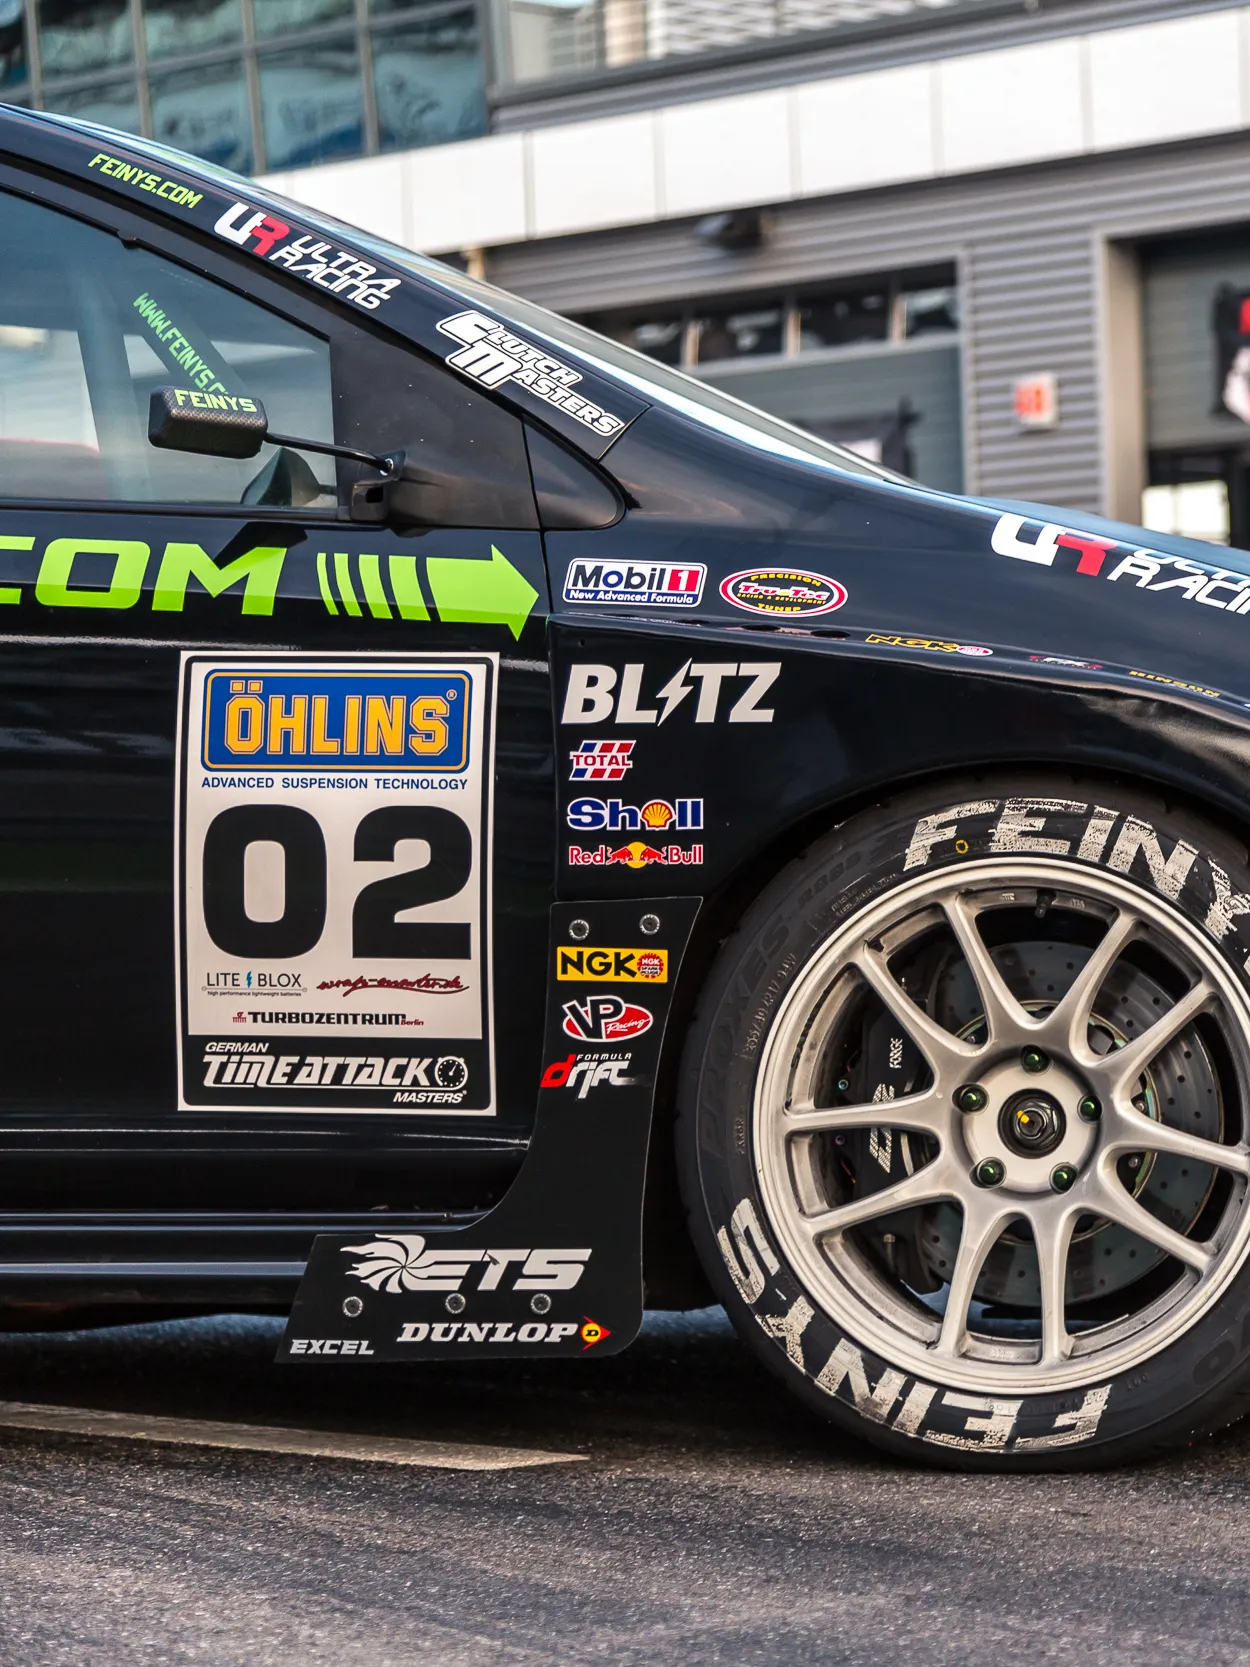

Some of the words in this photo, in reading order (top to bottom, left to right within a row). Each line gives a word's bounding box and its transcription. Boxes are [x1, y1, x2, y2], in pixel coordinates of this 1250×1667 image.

[88, 153, 203, 209] FEINYS.COM
[290, 235, 401, 292] ULTRA
[269, 246, 391, 310] RACING
[132, 292, 228, 395] WWW.FEINYS.C
[439, 311, 580, 386] CLUTCH
[449, 339, 620, 434] MASTERS
[174, 389, 257, 413] FEINYS
[572, 565, 666, 592] Mobil
[751, 573, 821, 587] PRECISION
[569, 590, 594, 600] New
[597, 591, 647, 602] Advanced
[650, 594, 693, 604] Formula
[225, 680, 449, 756] ÖHLINS
[572, 755, 632, 767] TOTAL
[202, 777, 274, 789] ADVANCED
[281, 777, 368, 790] SUSPENSION
[374, 778, 468, 791] TECHNOLOGY
[567, 797, 703, 831] Shll
[569, 846, 605, 865] Red
[668, 845, 703, 865] Bull
[202, 804, 472, 959] 02
[561, 951, 637, 978] NGK
[641, 957, 661, 966] NGK
[207, 973, 240, 987] LITE
[258, 973, 302, 988] BLOX
[248, 1011, 406, 1026] TURBOZENTRUM
[401, 1018, 424, 1026] Berlin
[563, 995, 624, 1040] VP
[606, 1018, 650, 1034] Racing
[205, 1042, 269, 1053] GERMAN
[576, 1053, 632, 1061] FORMULA
[293, 1057, 433, 1086] ATTACK
[393, 1092, 463, 1103] MASTERS
[397, 1323, 579, 1343] DUNLOP
[716, 1197, 1111, 1453] FEINYS
[290, 1340, 375, 1355] EXCEL
